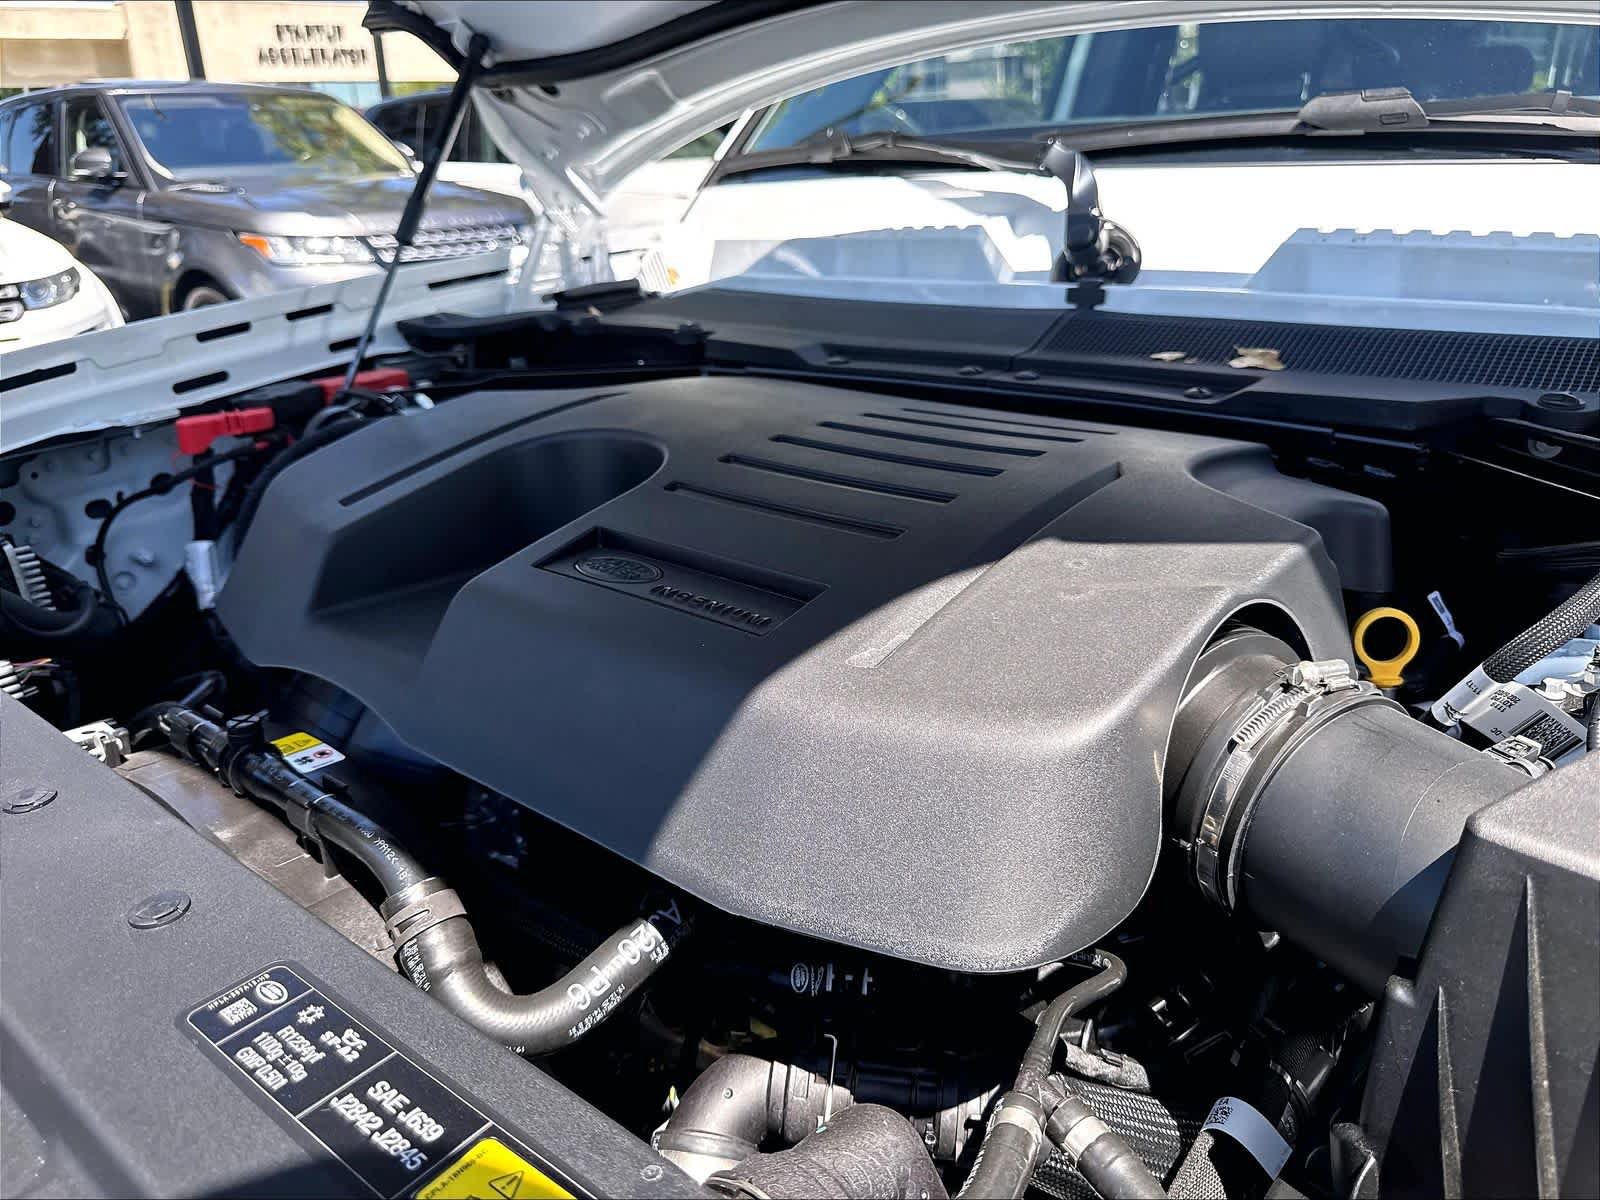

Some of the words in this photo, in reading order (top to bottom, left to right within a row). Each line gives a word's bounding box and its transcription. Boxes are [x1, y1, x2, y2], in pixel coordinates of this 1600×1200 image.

[650, 583, 773, 627] INGENIUM
[235, 1046, 267, 1070] GWP
[276, 1024, 327, 1065] R1234yf
[329, 1092, 384, 1137] J2842
[370, 1127, 428, 1170] J2845
[366, 1080, 412, 1115] SAE
[396, 1106, 445, 1143] J639
